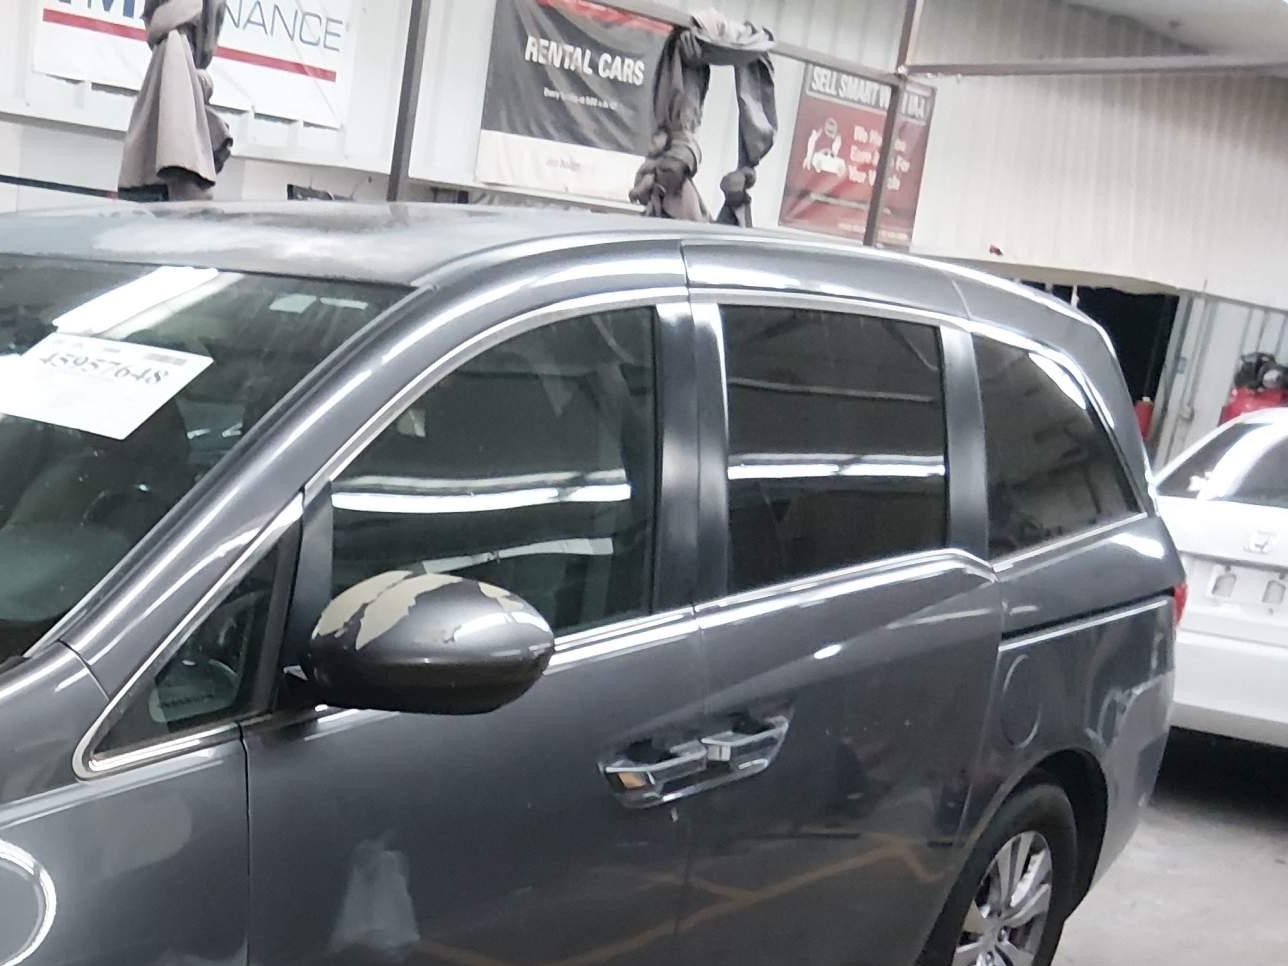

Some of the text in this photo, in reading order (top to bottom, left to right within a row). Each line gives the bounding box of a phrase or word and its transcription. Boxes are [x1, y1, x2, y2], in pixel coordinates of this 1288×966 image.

[223, 0, 343, 52] NANCE
[525, 35, 645, 87] RENTAL CARS
